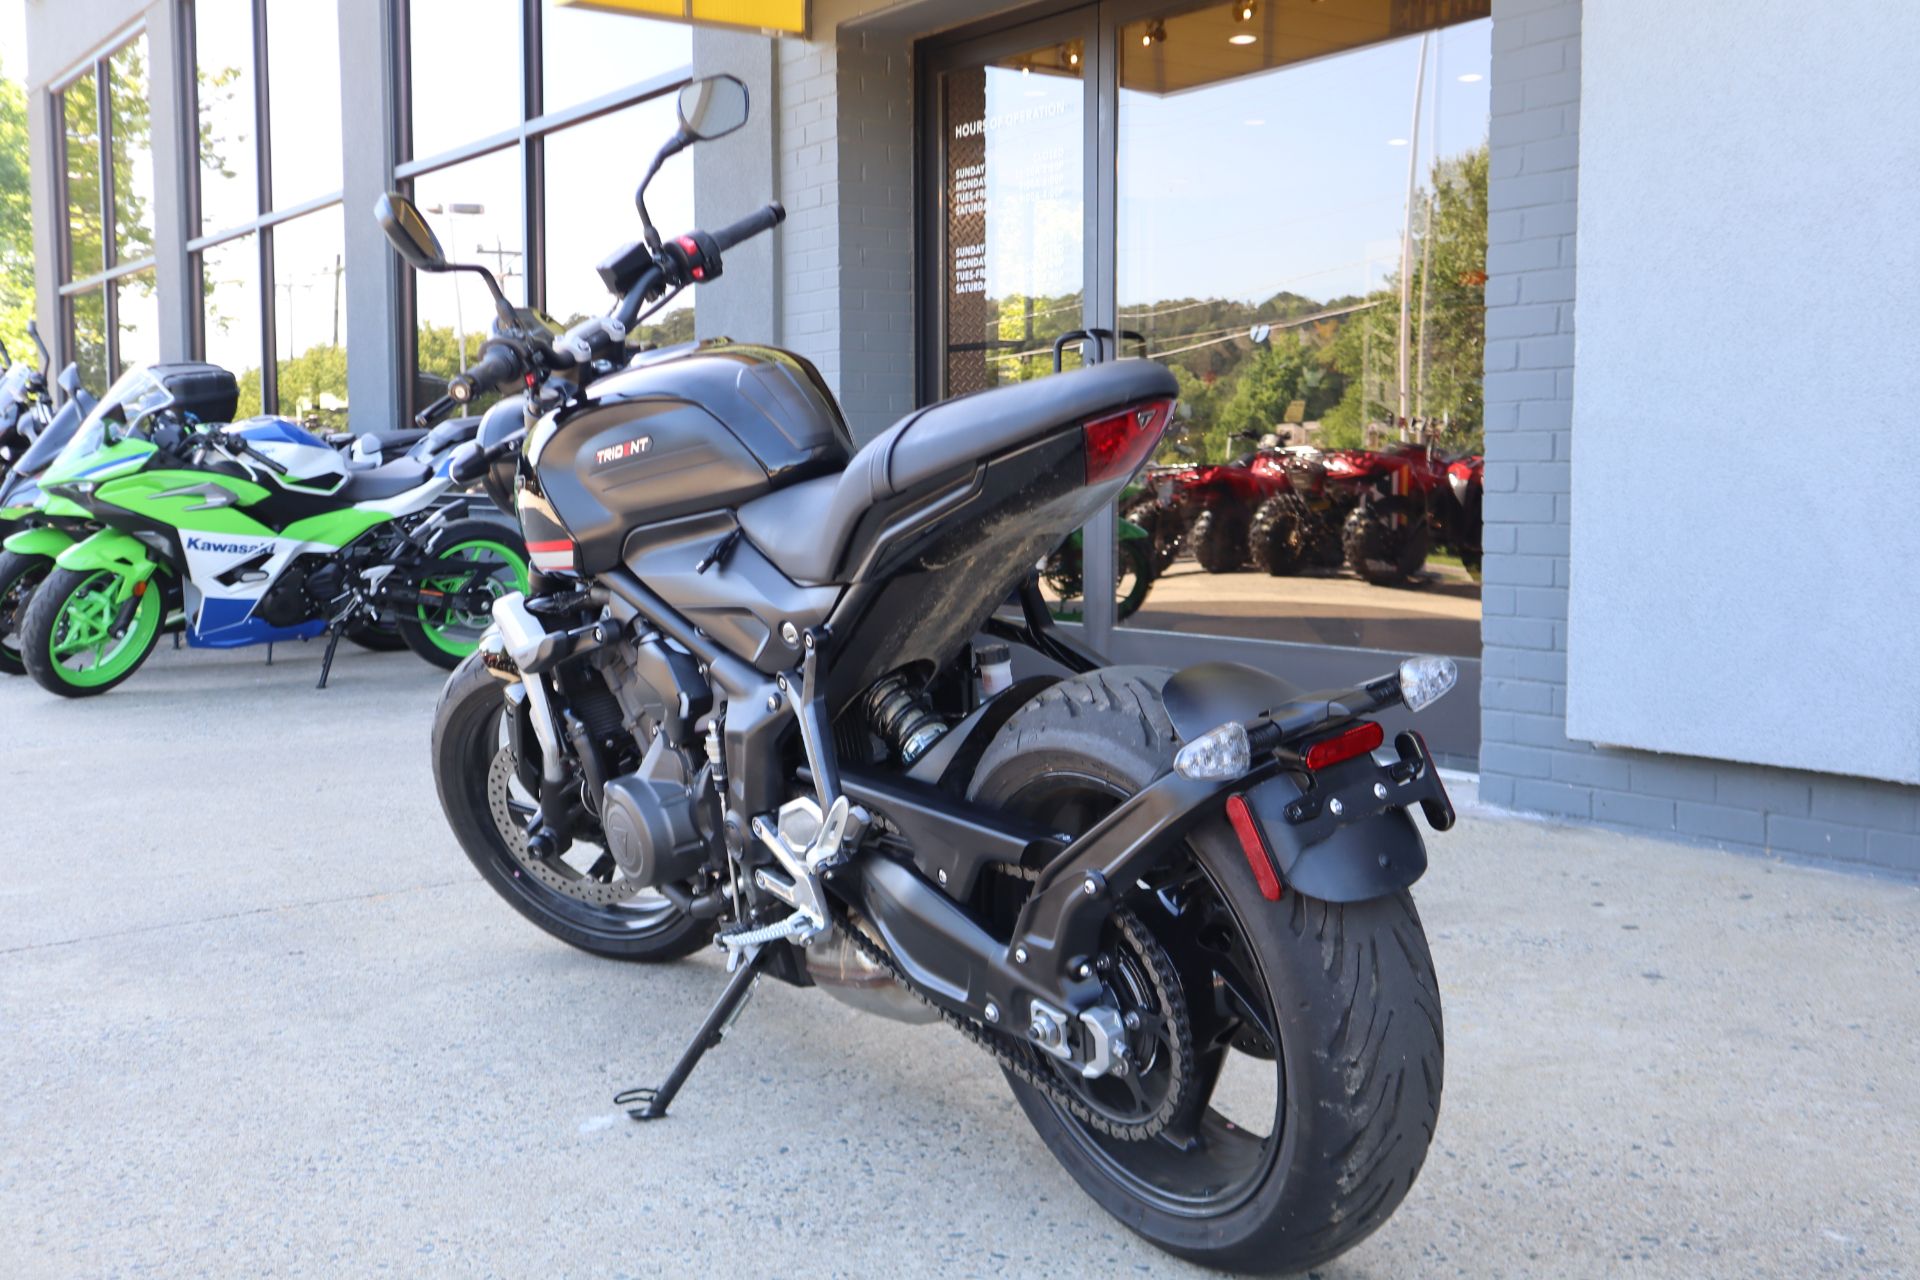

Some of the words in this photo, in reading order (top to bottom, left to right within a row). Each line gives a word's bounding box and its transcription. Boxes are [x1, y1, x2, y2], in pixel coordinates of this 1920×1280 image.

[955, 119, 987, 139] HOURS
[955, 163, 985, 180] SUNDAY
[955, 243, 985, 258] SUNDAY
[596, 436, 649, 464] TRIDENT
[186, 537, 276, 555] Kawasaki
